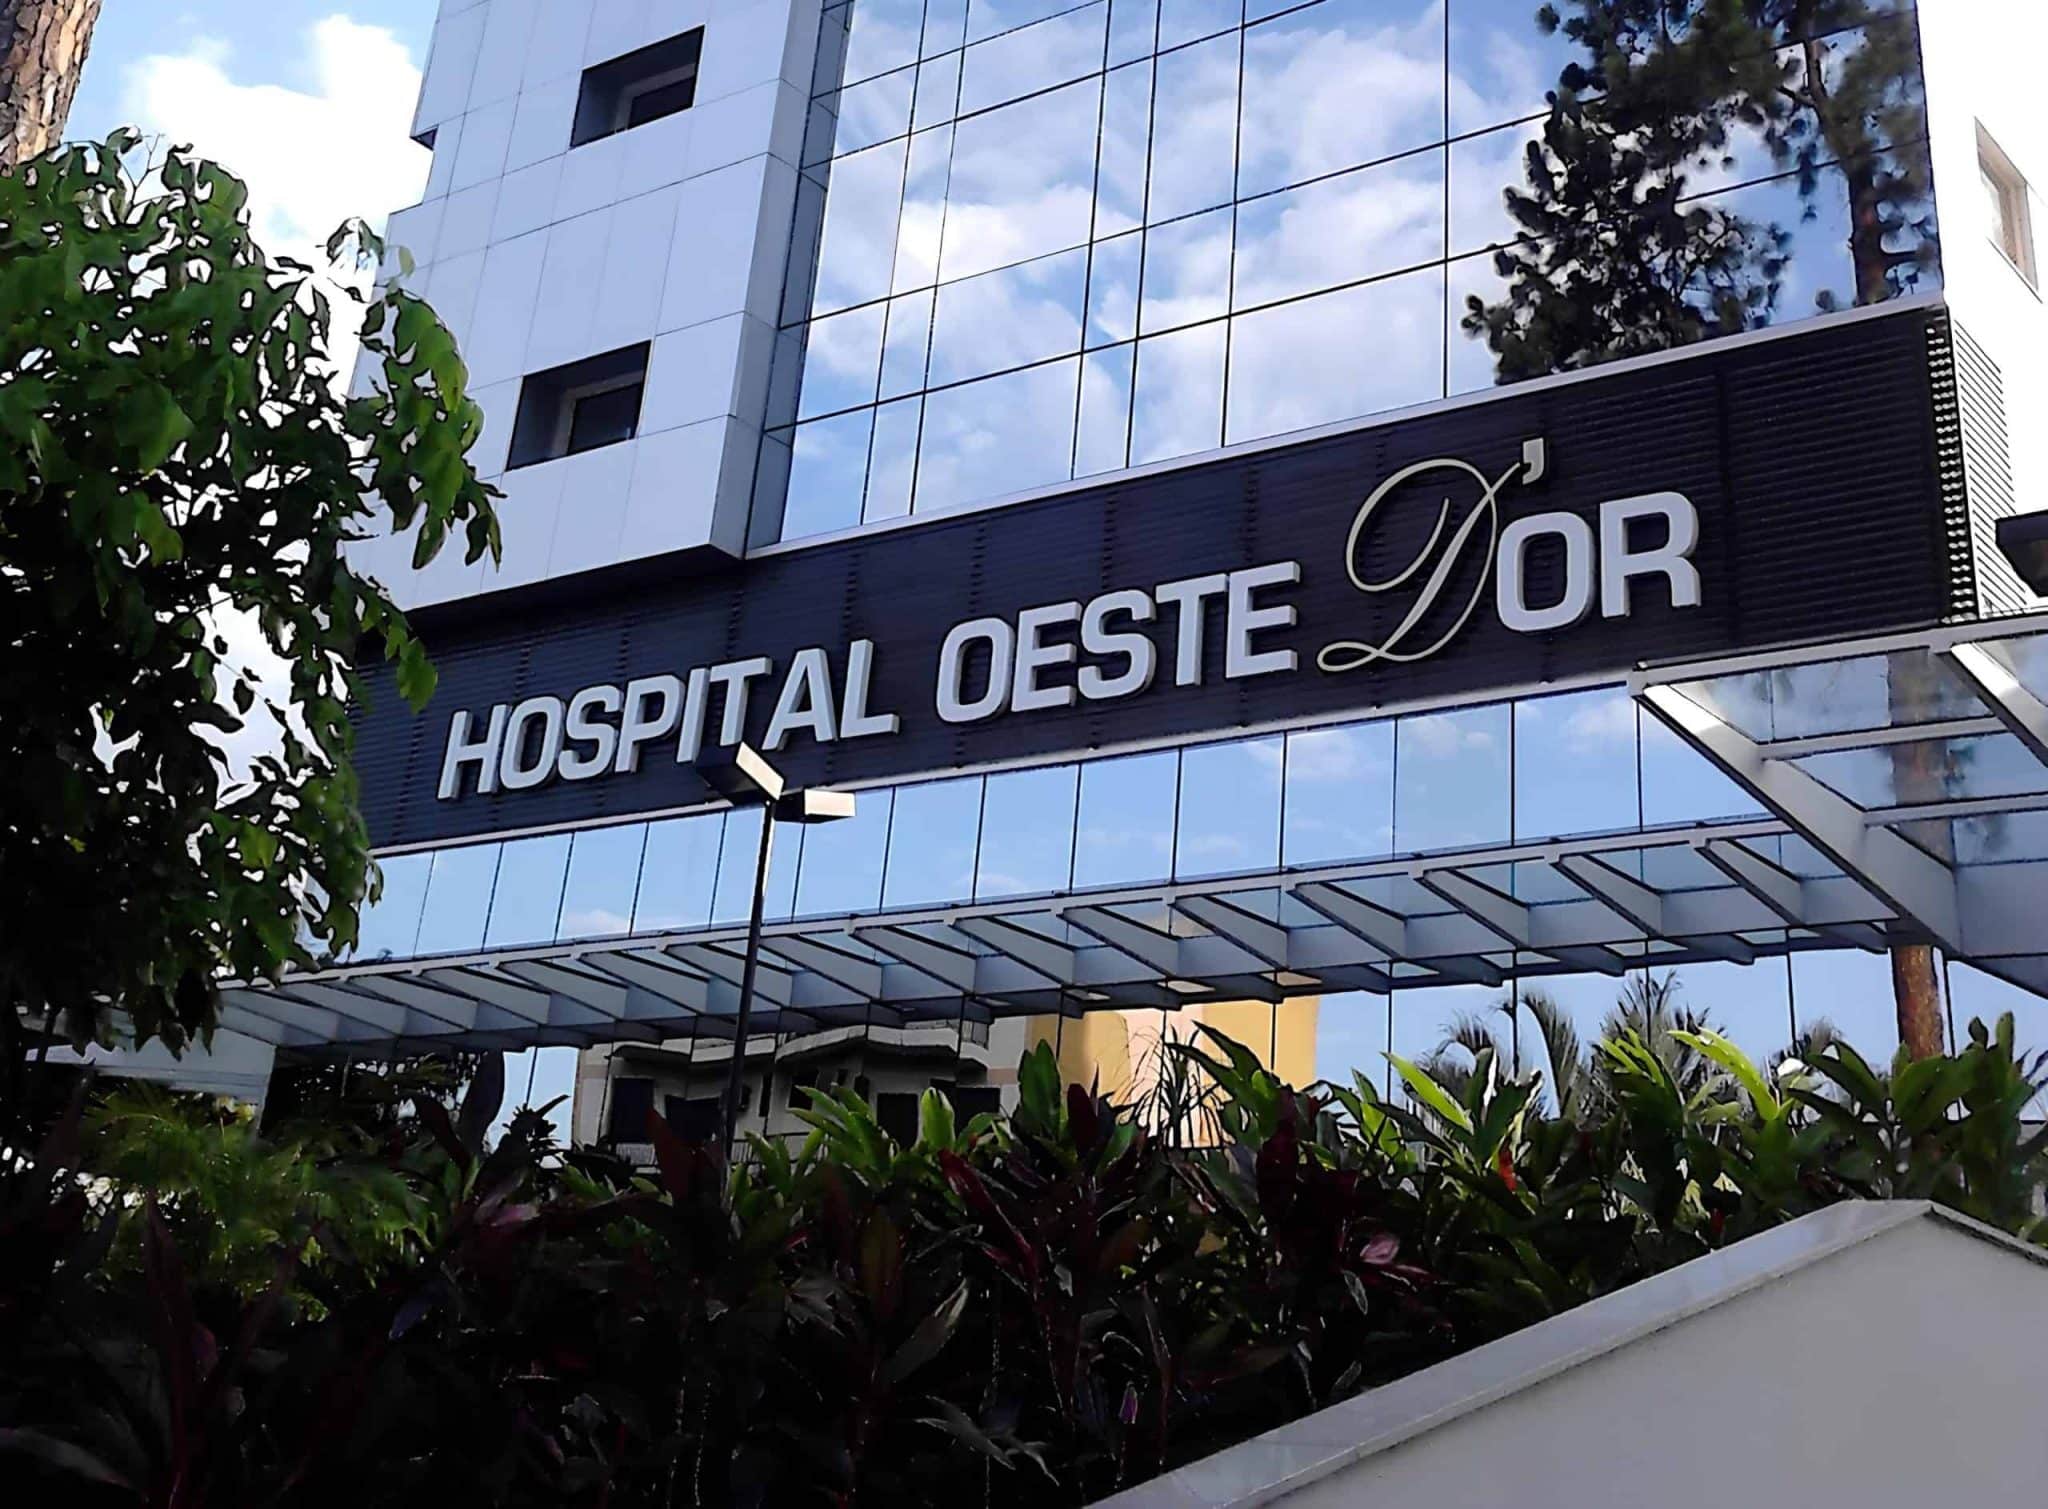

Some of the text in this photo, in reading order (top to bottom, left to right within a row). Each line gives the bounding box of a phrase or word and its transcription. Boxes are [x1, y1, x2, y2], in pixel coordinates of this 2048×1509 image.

[437, 437, 1701, 801] HOSPITAL OESTE D'OR
